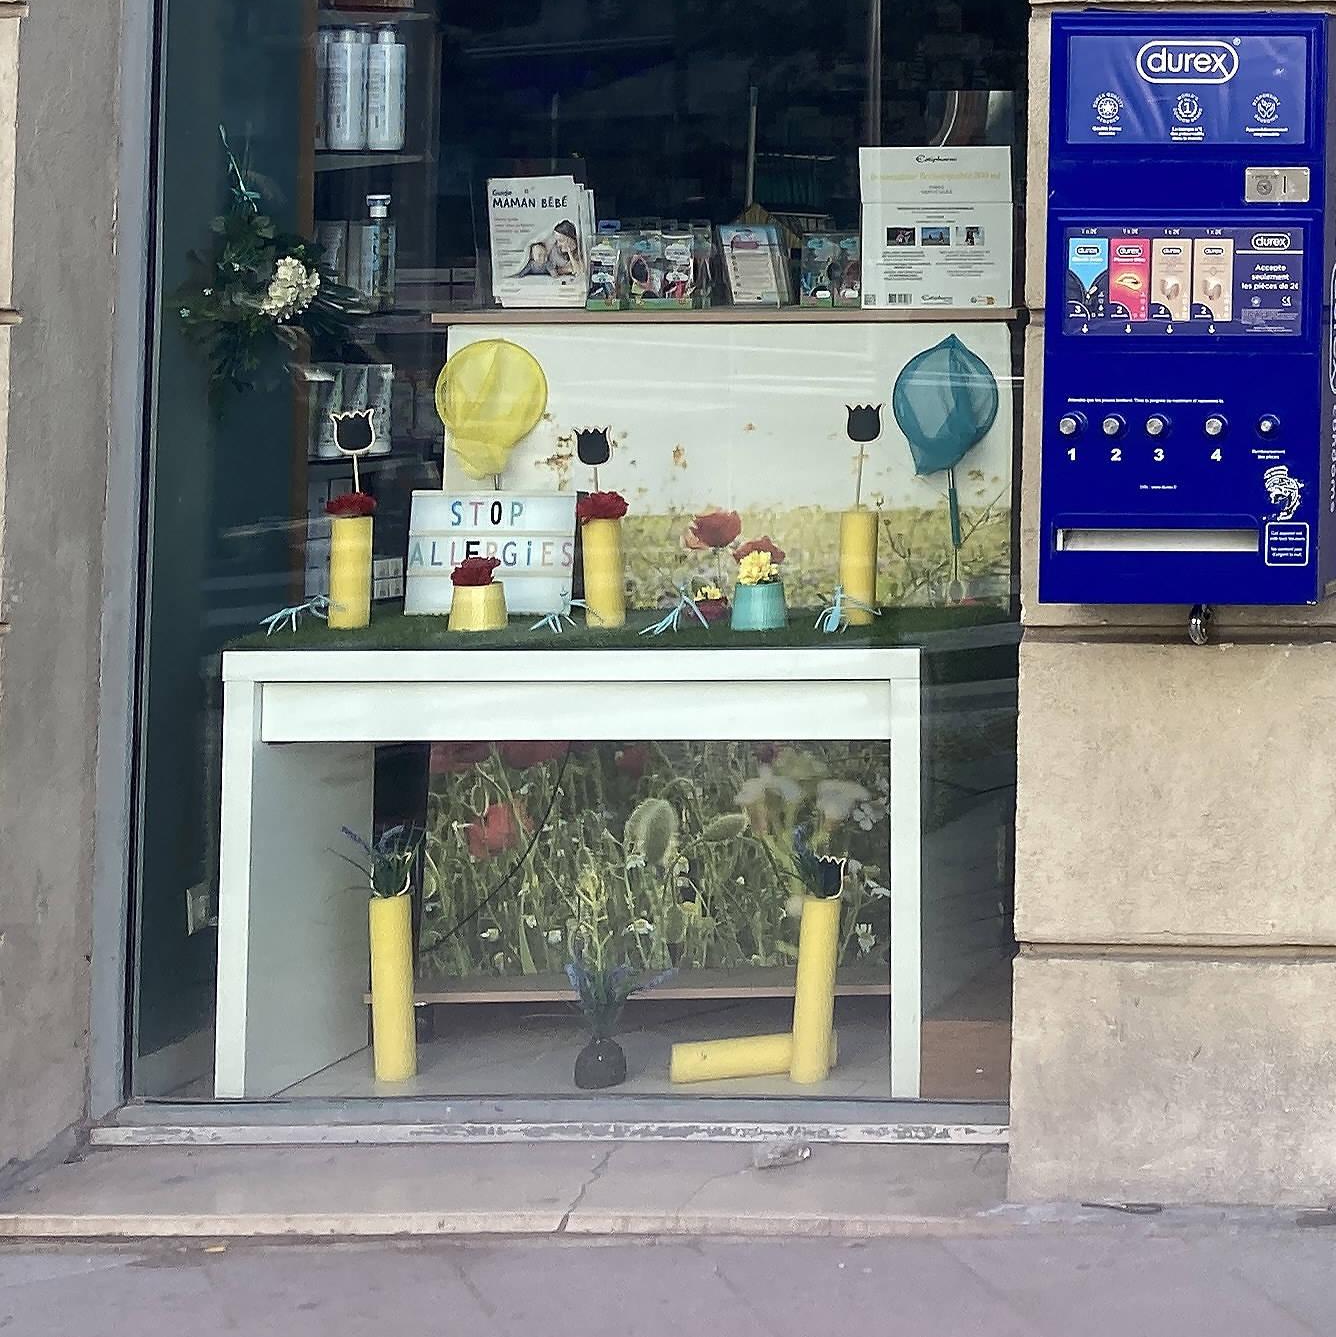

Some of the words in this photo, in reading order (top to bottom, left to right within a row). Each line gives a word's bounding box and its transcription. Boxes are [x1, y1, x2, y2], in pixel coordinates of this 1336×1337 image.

[1146, 47, 1230, 76] durex
[493, 198, 536, 209] MAMAN
[541, 195, 568, 208] BÉBÉ
[1255, 237, 1287, 248] durex
[1067, 448, 1076, 461] 1
[1110, 448, 1122, 461] 2
[1153, 448, 1165, 461] 3
[1210, 448, 1222, 461] 4
[451, 500, 524, 526] STOP
